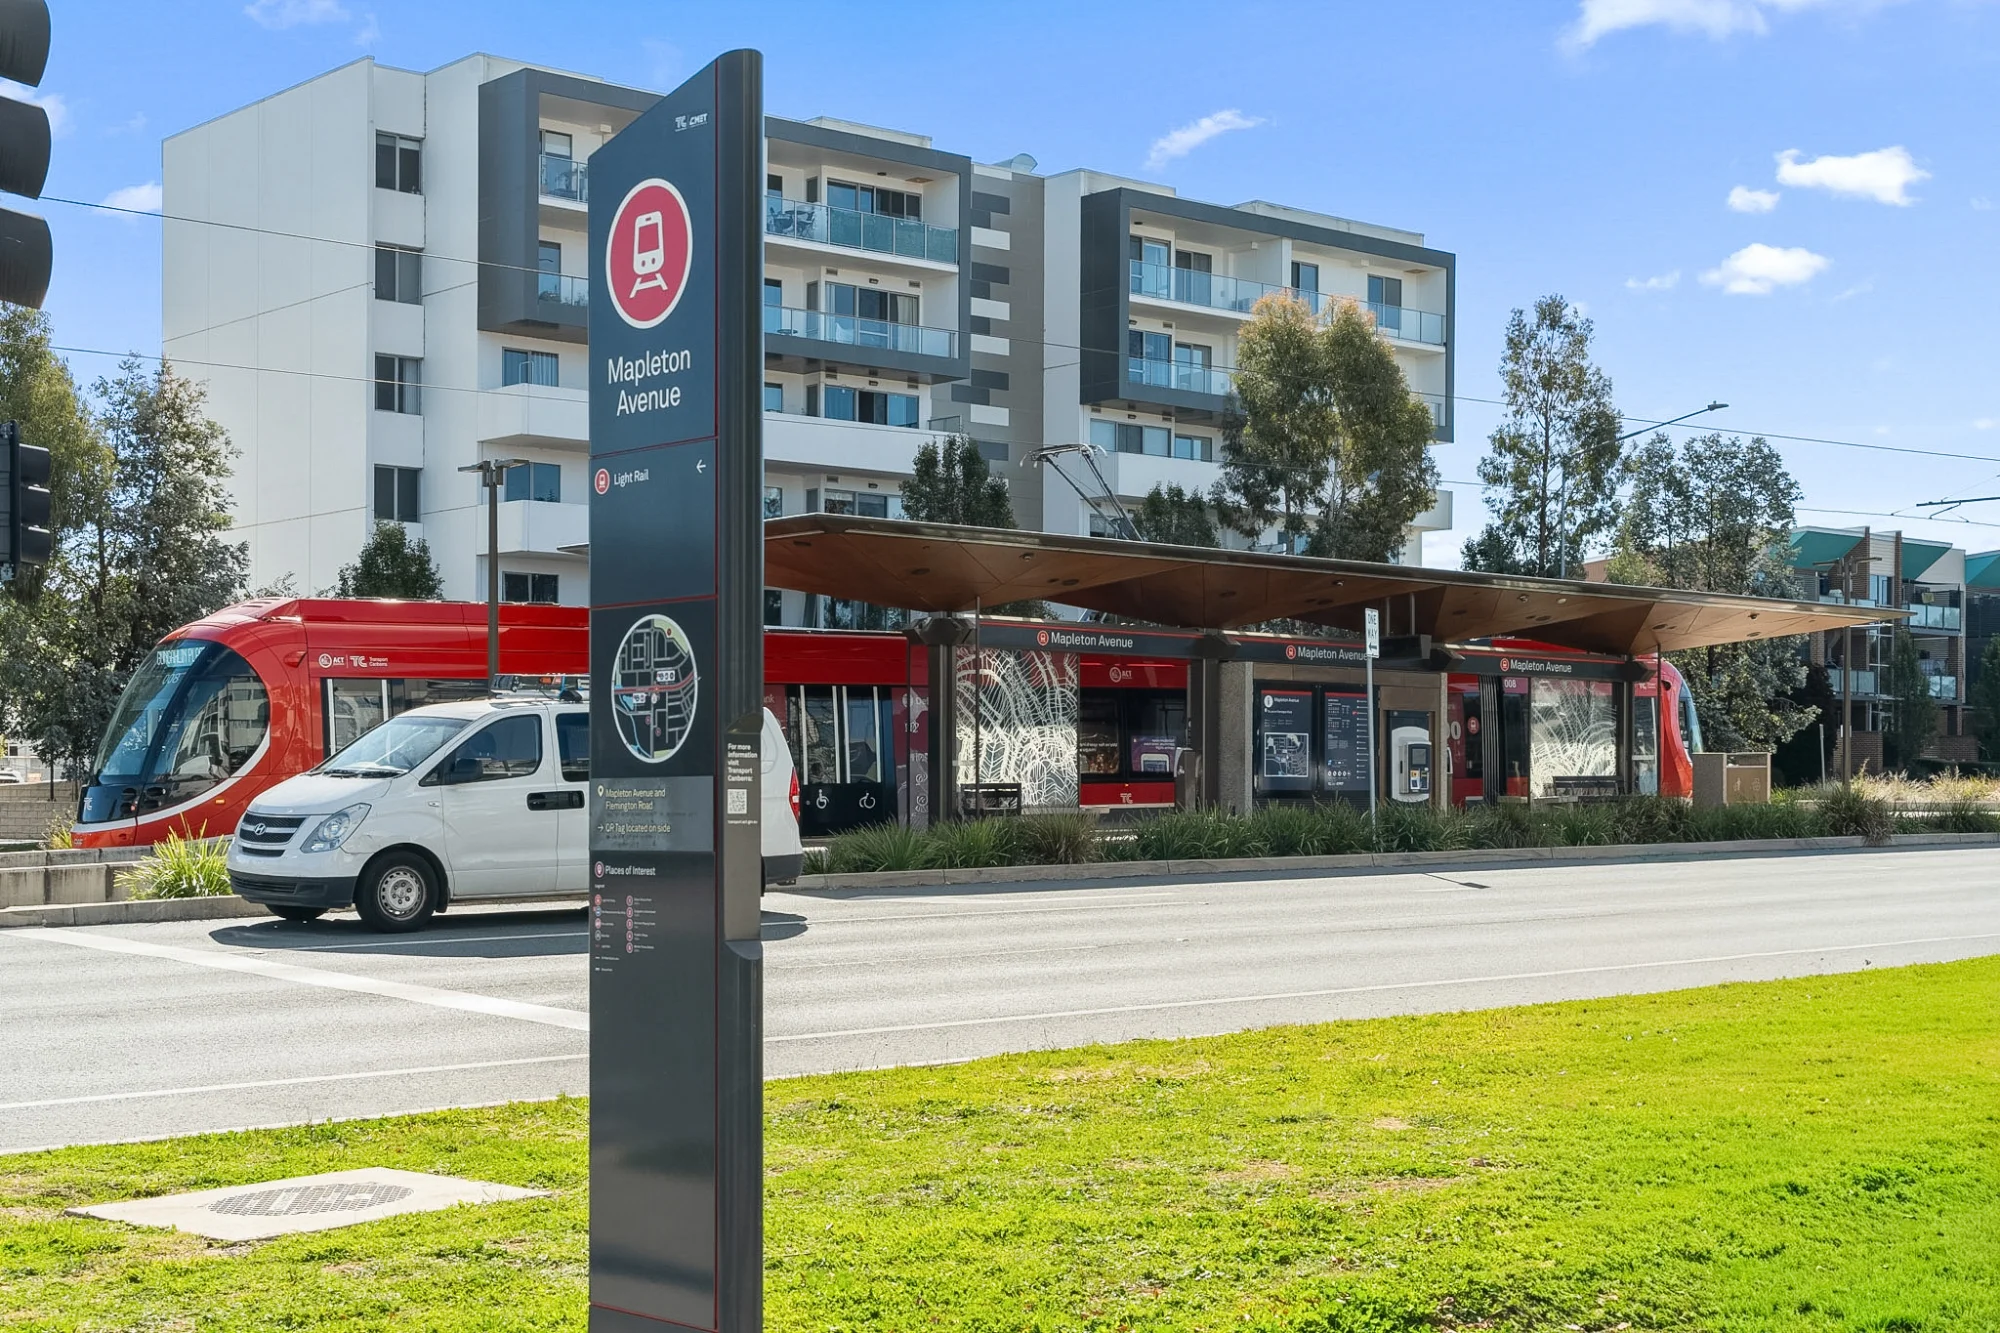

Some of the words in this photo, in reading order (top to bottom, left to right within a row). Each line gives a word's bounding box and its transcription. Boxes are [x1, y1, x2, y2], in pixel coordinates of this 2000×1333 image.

[608, 349, 690, 386] Mapleton
[617, 387, 680, 416] Avenue
[614, 472, 633, 487] Light
[634, 469, 649, 482] Rail
[1368, 614, 1376, 625] ONE
[1051, 631, 1097, 647] Mapleton
[1098, 635, 1133, 648] Avenue
[1367, 629, 1377, 639] WAY
[1298, 646, 1337, 660] Mapleton
[1338, 649, 1369, 661] Avenue
[349, 656, 367, 667] TC
[1510, 659, 1545, 672] Mapleton
[1545, 662, 1572, 673] Avenue
[1504, 680, 1516, 688] 008
[606, 788, 632, 799] Mapleton
[633, 788, 653, 797] Avenue
[654, 787, 666, 797] and
[638, 801, 653, 810] Road
[615, 823, 625, 834] Tag
[626, 823, 648, 832] located
[657, 823, 671, 832] side
[605, 866, 624, 875] Places
[625, 866, 632, 875] of
[633, 866, 656, 876] Interest
